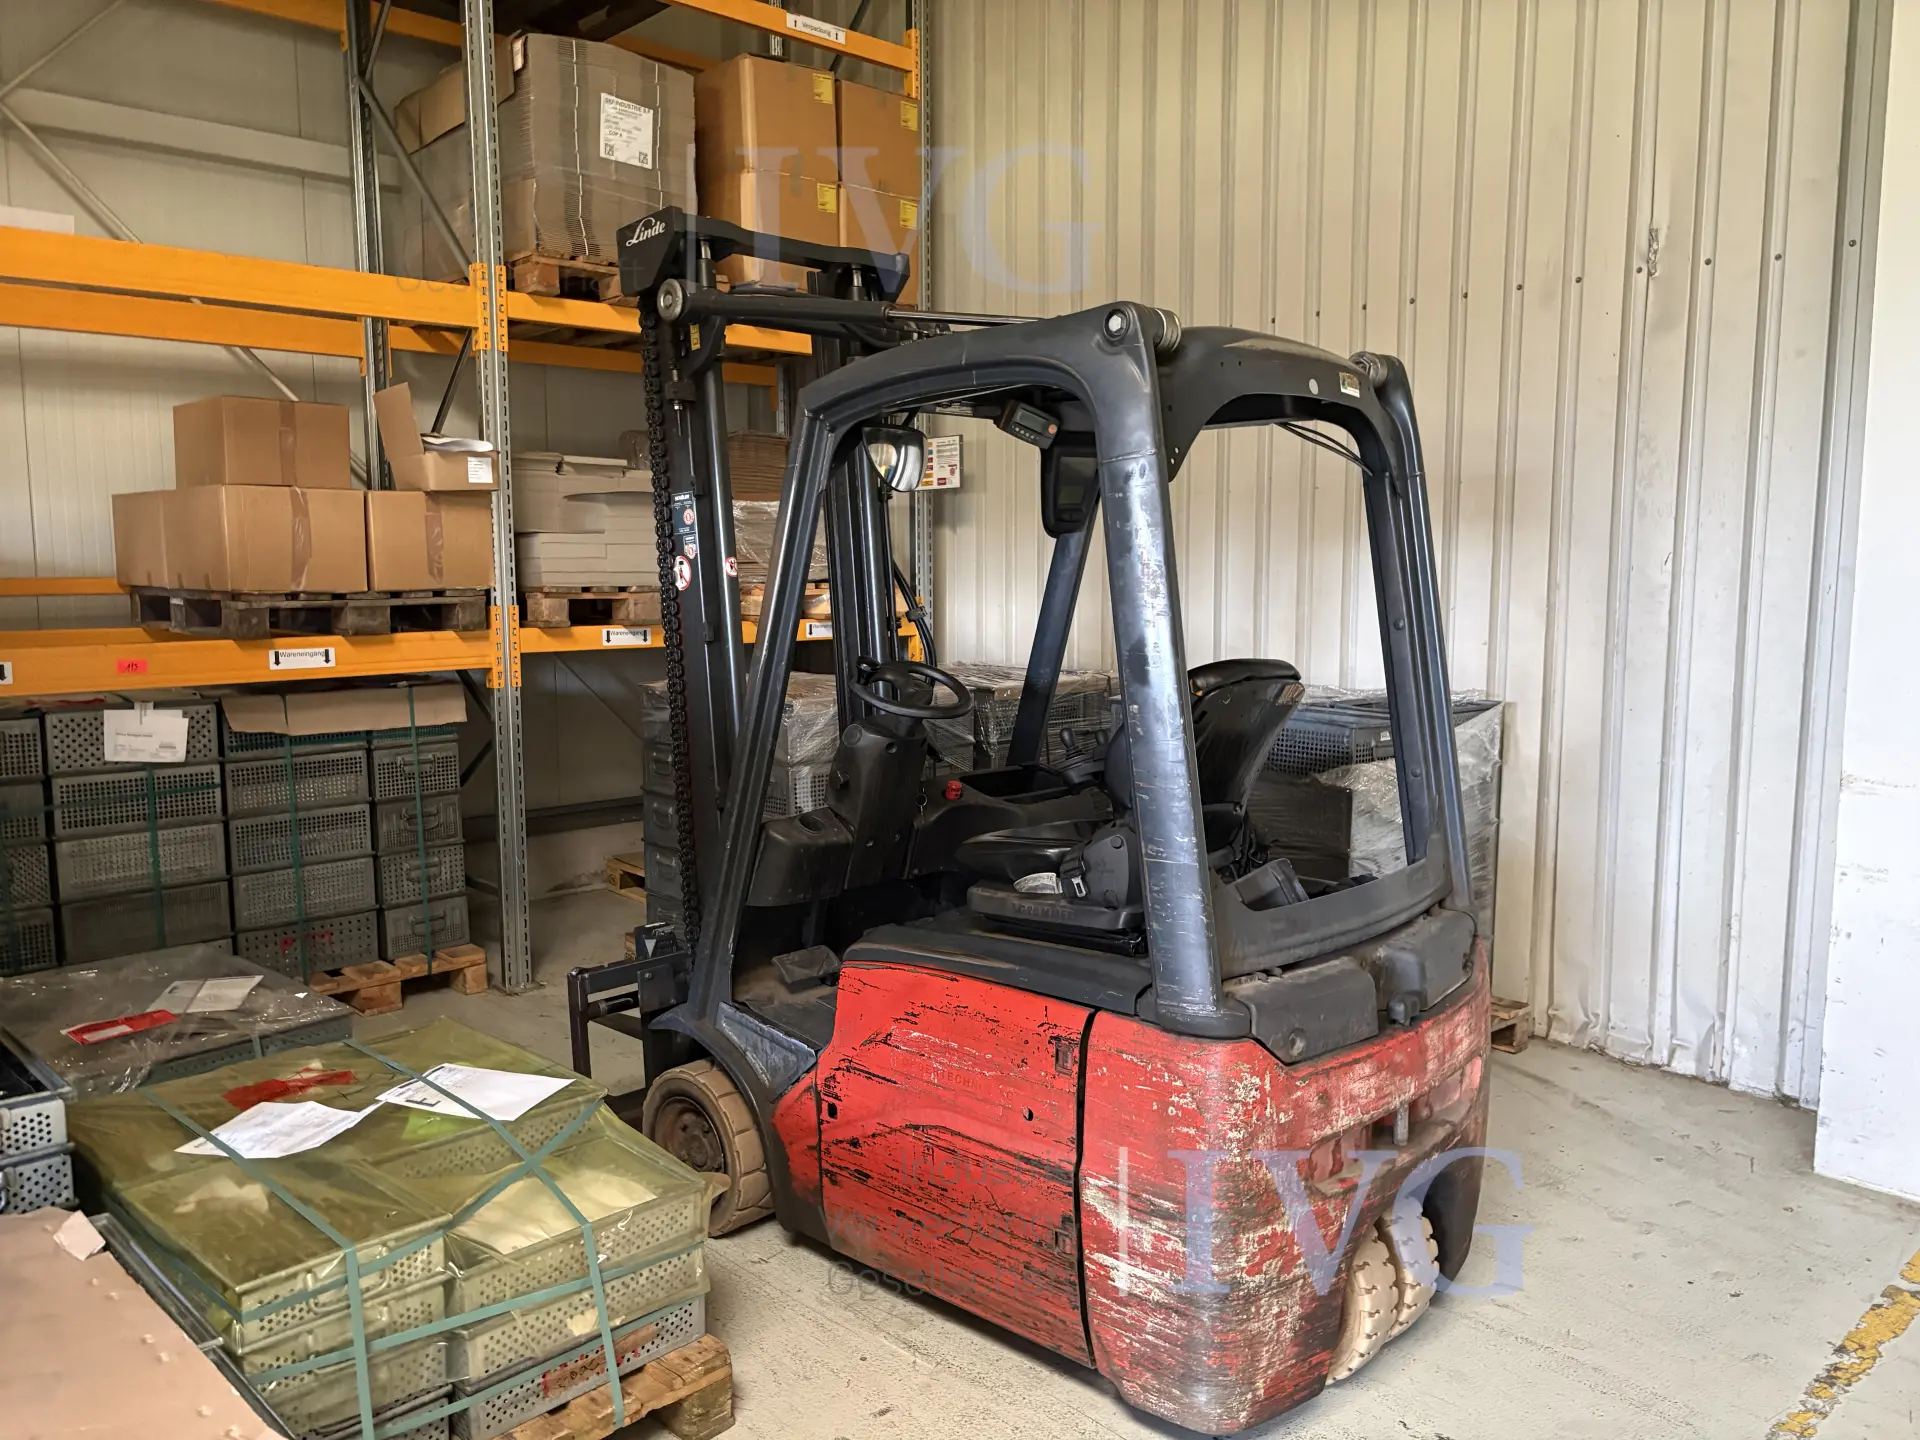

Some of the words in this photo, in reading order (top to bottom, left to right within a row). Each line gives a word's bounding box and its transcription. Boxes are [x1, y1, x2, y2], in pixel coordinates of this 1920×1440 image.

[802, 21, 832, 37] Verpackung
[625, 216, 666, 247] Linde
[279, 649, 326, 658] Wareneingang
